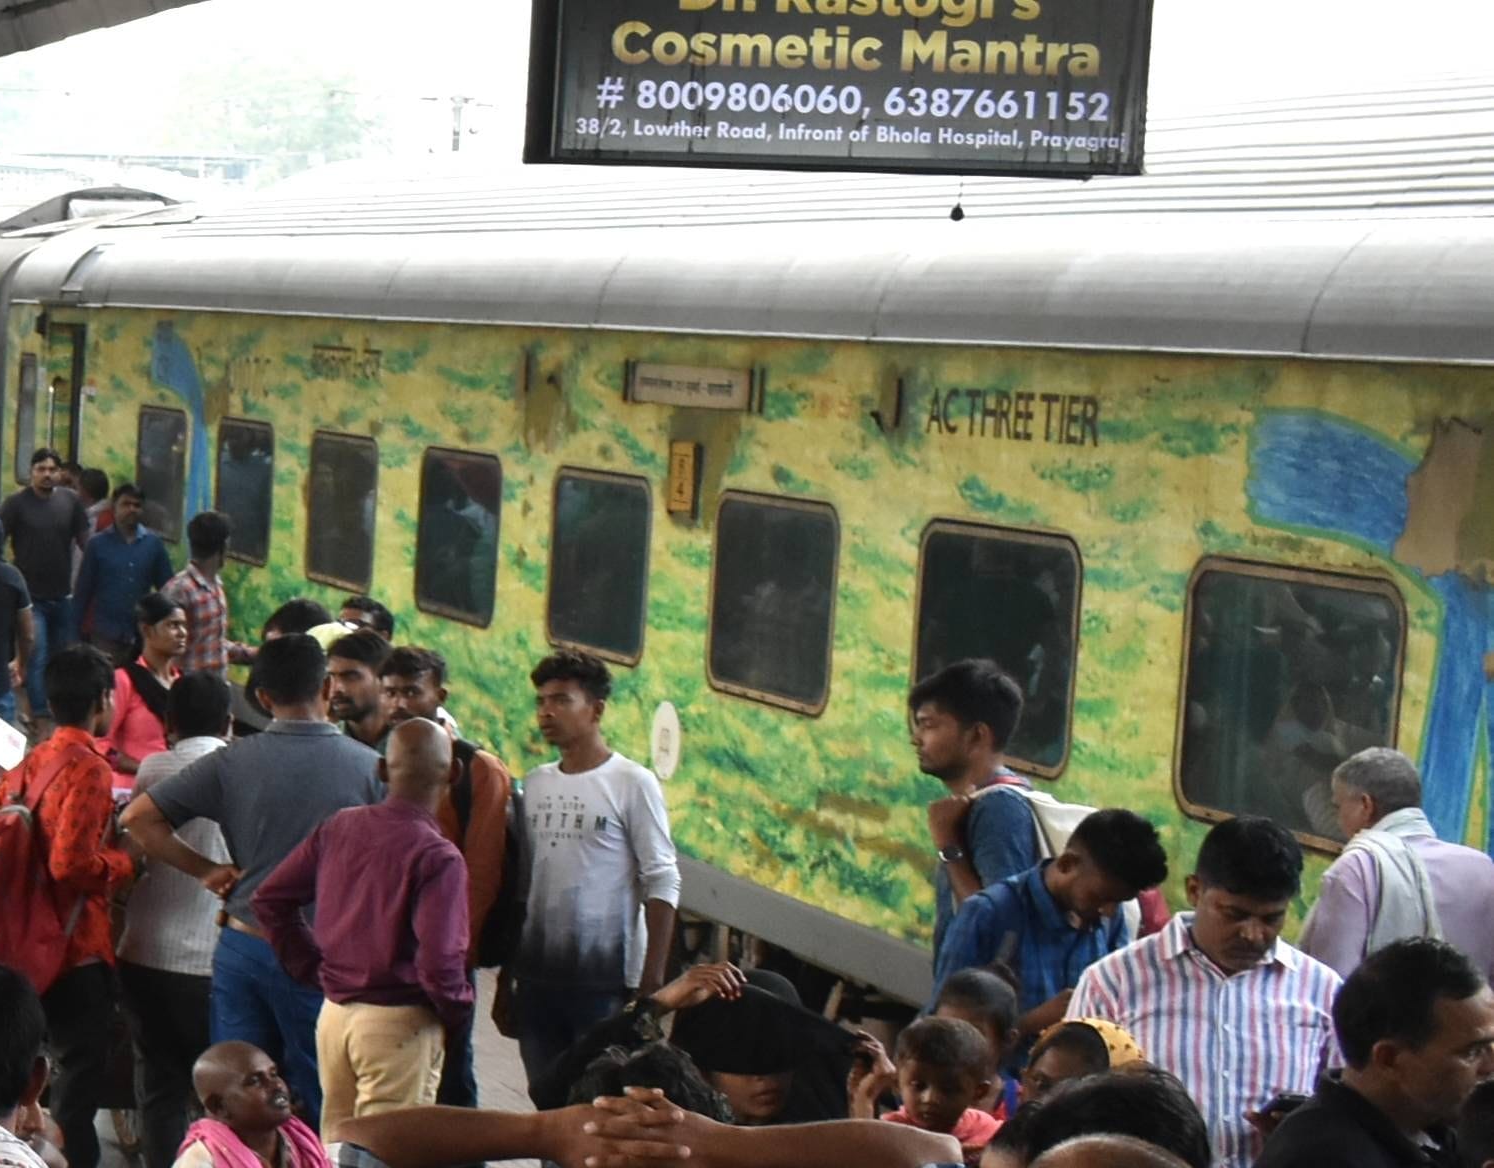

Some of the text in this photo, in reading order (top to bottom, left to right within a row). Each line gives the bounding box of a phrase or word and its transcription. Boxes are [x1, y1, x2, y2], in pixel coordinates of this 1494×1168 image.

[611, 20, 1100, 77] Cosmetic Mantra
[596, 77, 1110, 121] # 8009806060, 6387661152
[576, 117, 1128, 151] 38/2, Lowther Road, Infront of Bhola Hospital, Prayagraj
[925, 388, 1099, 448] AC THREE TIER
